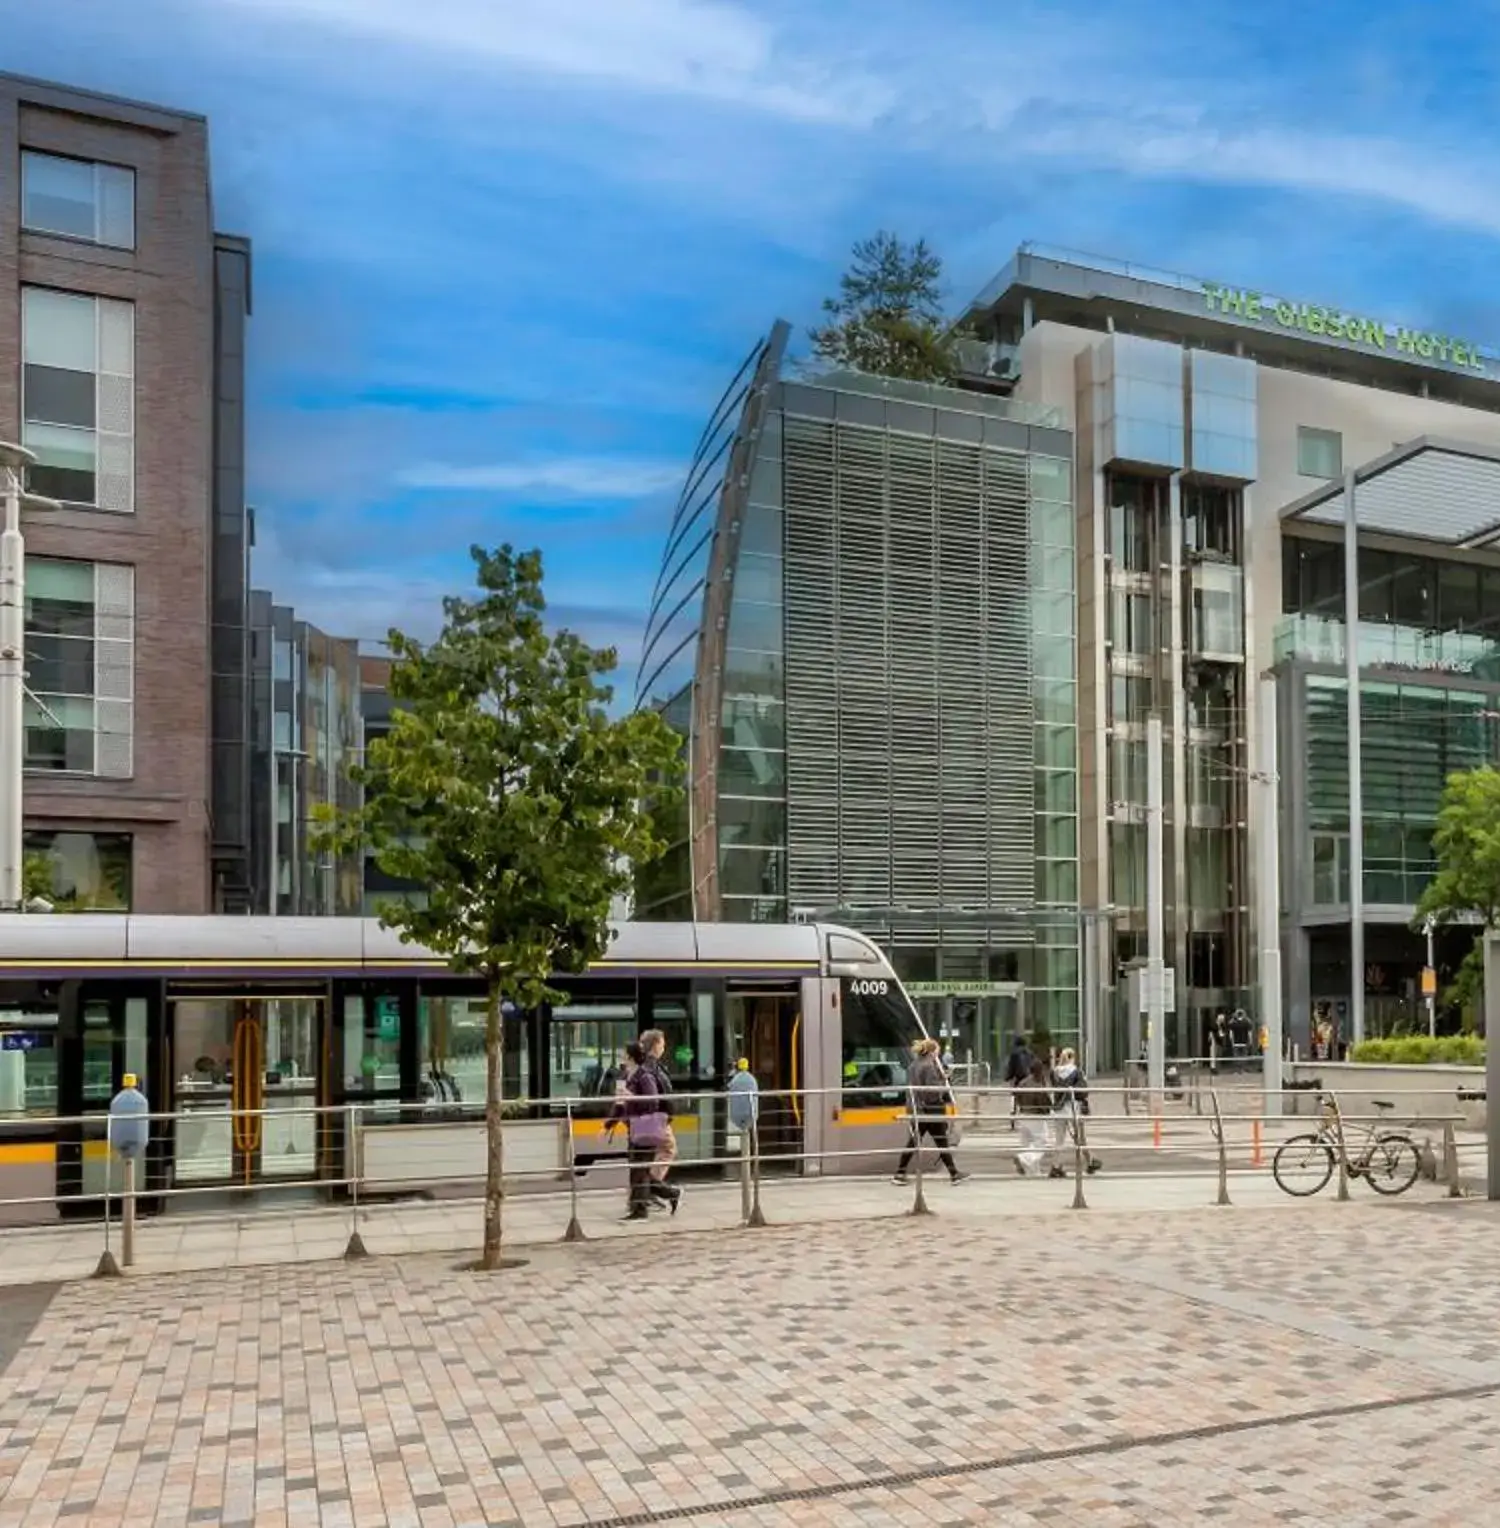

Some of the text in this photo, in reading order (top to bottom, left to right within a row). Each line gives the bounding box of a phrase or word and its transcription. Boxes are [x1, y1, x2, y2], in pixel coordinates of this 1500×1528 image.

[1201, 281, 1485, 370] THE GIBSON HOTEL
[850, 979, 889, 996] 4009
